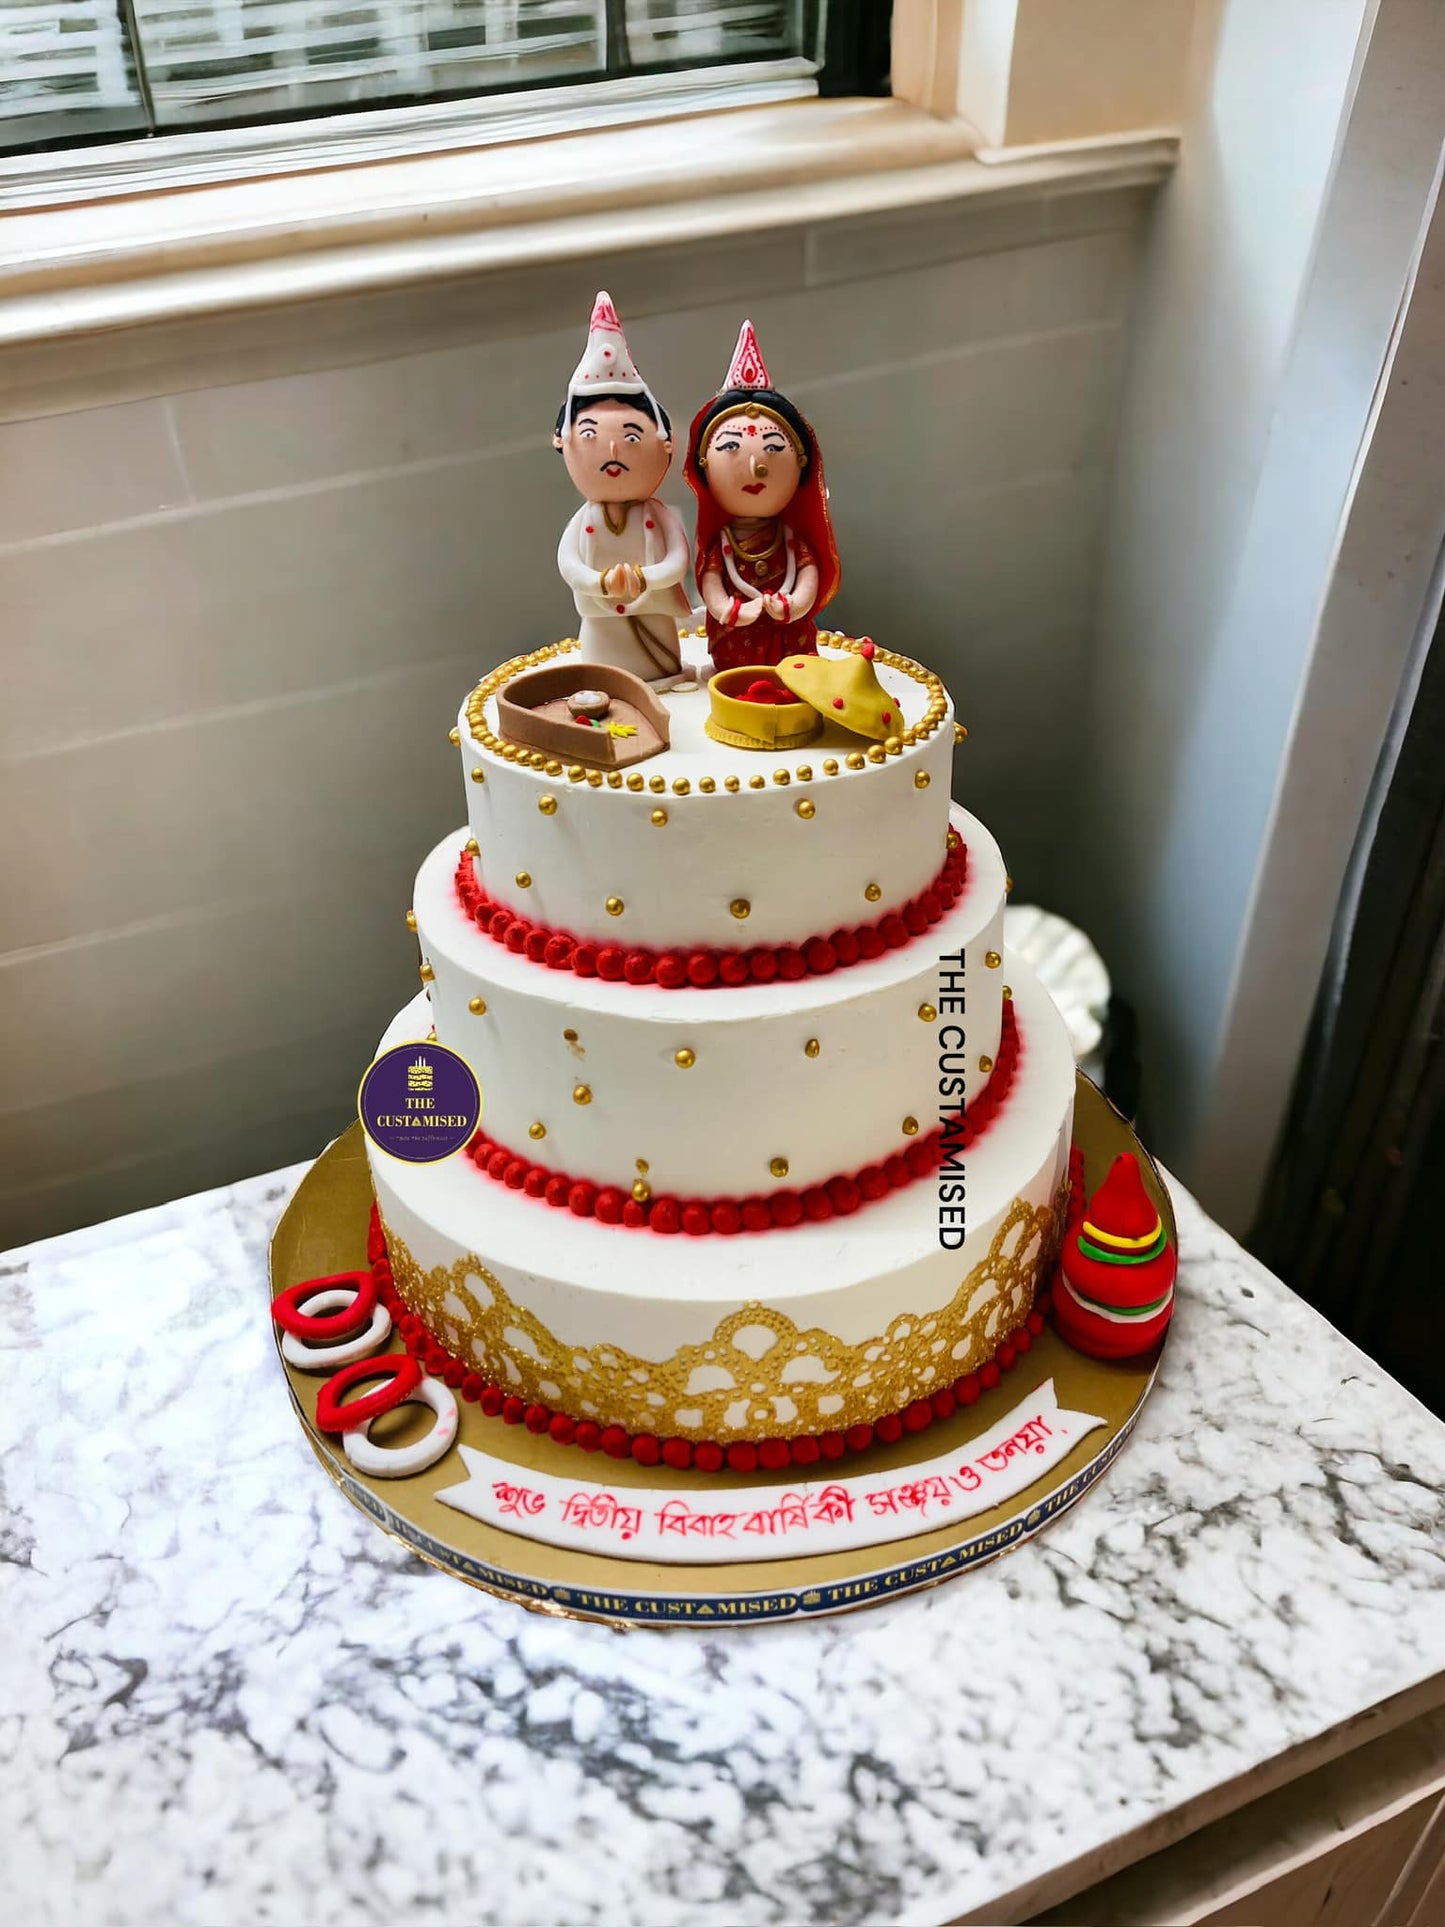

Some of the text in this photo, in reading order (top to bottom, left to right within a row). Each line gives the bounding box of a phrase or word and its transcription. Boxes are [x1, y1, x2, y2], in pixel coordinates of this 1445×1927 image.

[949, 1465, 983, 1491] ও
[1045, 1480, 1079, 1511] THE
[828, 1522, 1024, 1601] THE CUSTAMISED
[577, 1591, 797, 1615] THE CUSTAMISED
